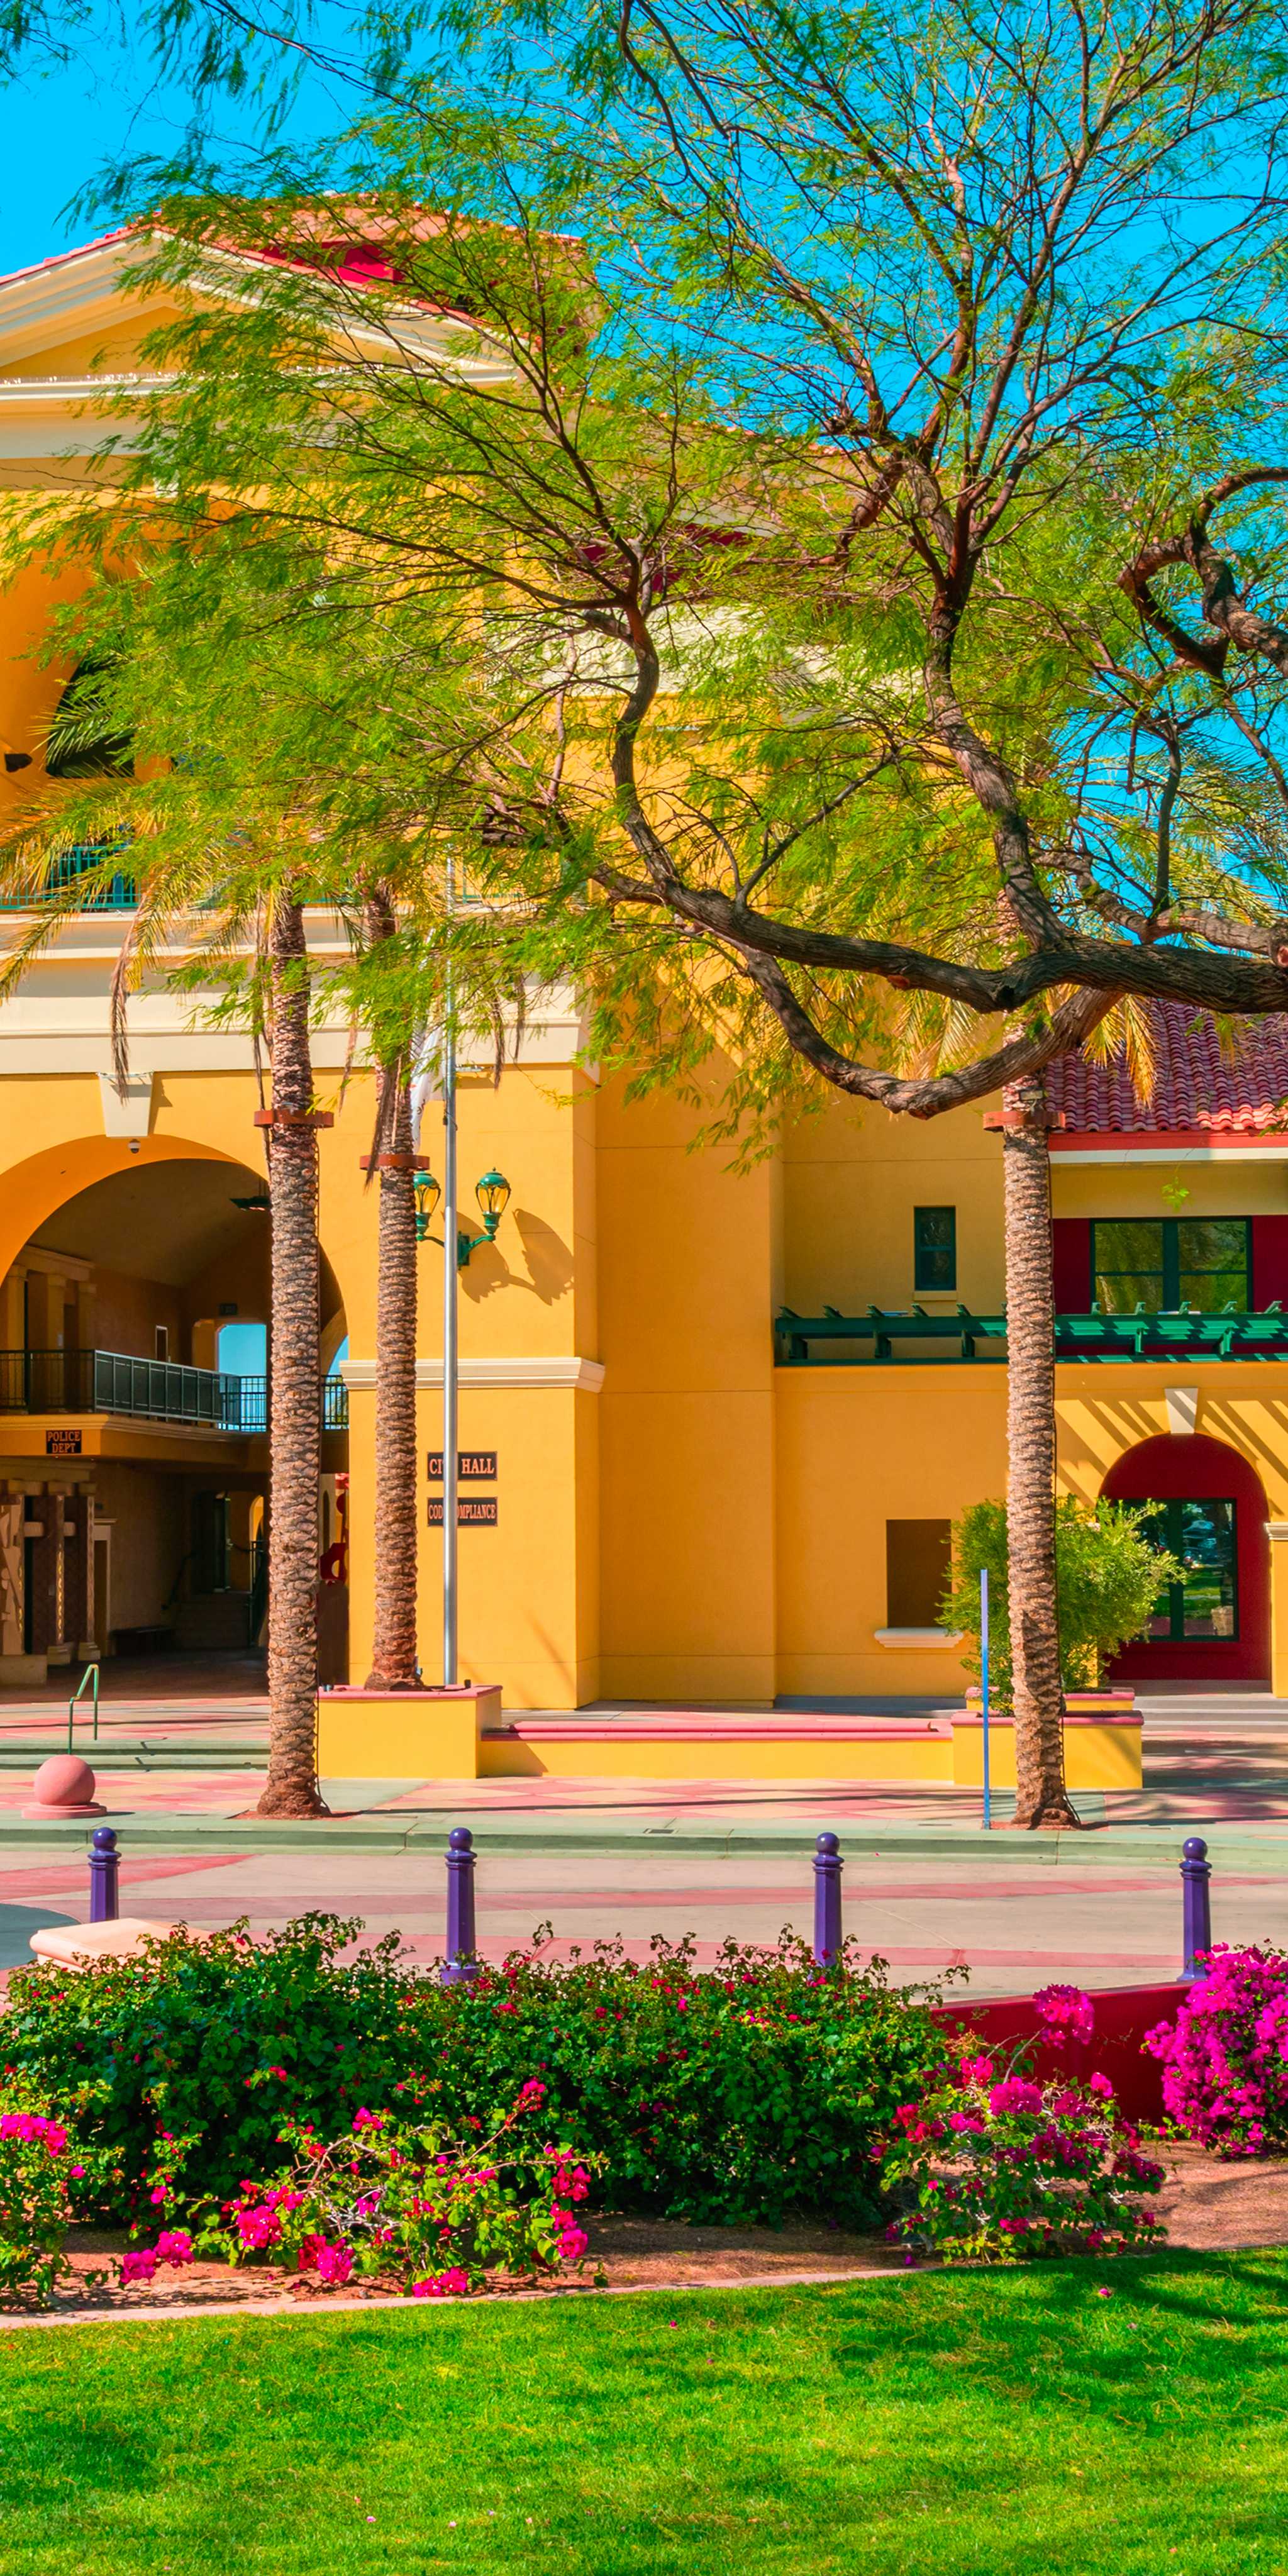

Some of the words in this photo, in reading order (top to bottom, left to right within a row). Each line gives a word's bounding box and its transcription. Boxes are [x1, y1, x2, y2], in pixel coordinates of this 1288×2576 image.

[48, 1431, 80, 1441] POLICE
[52, 1443, 76, 1453] DEPT
[462, 1458, 494, 1474] HALL
[429, 1504, 443, 1519] COD
[457, 1504, 496, 1519] MPLIANCE
